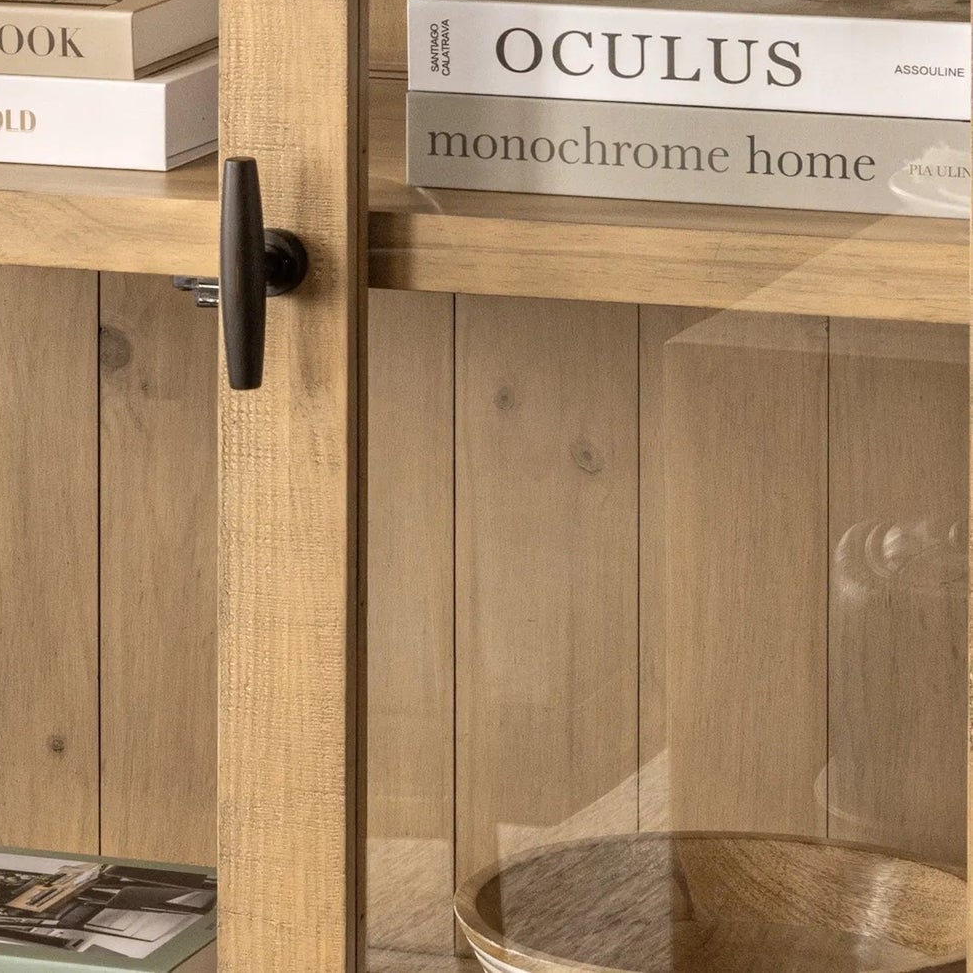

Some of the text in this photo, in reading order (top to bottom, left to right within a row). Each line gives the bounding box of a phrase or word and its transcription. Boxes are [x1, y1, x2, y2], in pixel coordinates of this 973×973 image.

[429, 22, 440, 73] SANTIAGO
[441, 18, 451, 77] CALATRAVA
[495, 27, 803, 88] OCULUS
[894, 64, 965, 78] ASSOULINE
[427, 126, 877, 182] monochrome home
[909, 163, 933, 177] PIA
